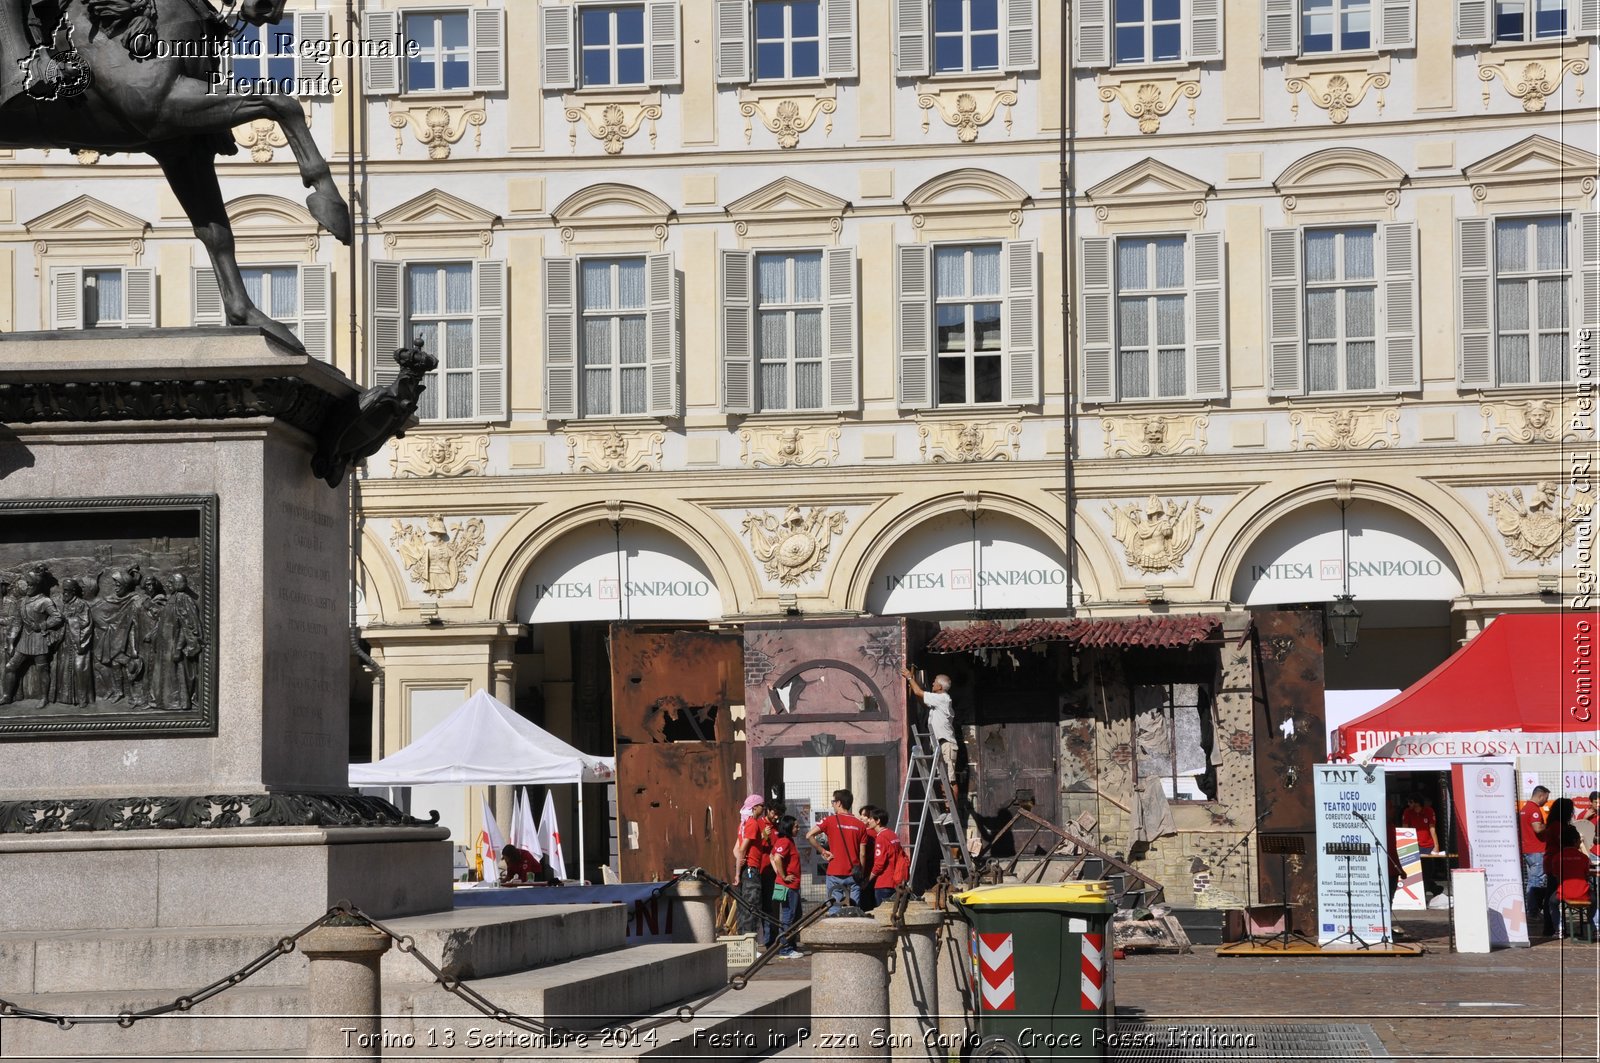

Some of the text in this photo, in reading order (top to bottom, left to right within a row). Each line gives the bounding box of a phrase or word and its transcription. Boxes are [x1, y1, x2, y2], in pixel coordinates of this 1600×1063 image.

[1251, 560, 1442, 581] INTESA SANPAOLO
[886, 569, 1065, 591] INTESA SANPAOLO
[535, 581, 709, 599] INTESA SANPAOLO
[1395, 742, 1457, 756] CROCE
[1462, 741, 1521, 755] ROSSA
[1320, 770, 1359, 782] TNT
[1340, 791, 1360, 800] LICEO
[1323, 802, 1377, 811] TEATRO NUOVO
[1341, 835, 1362, 844] CORSI
